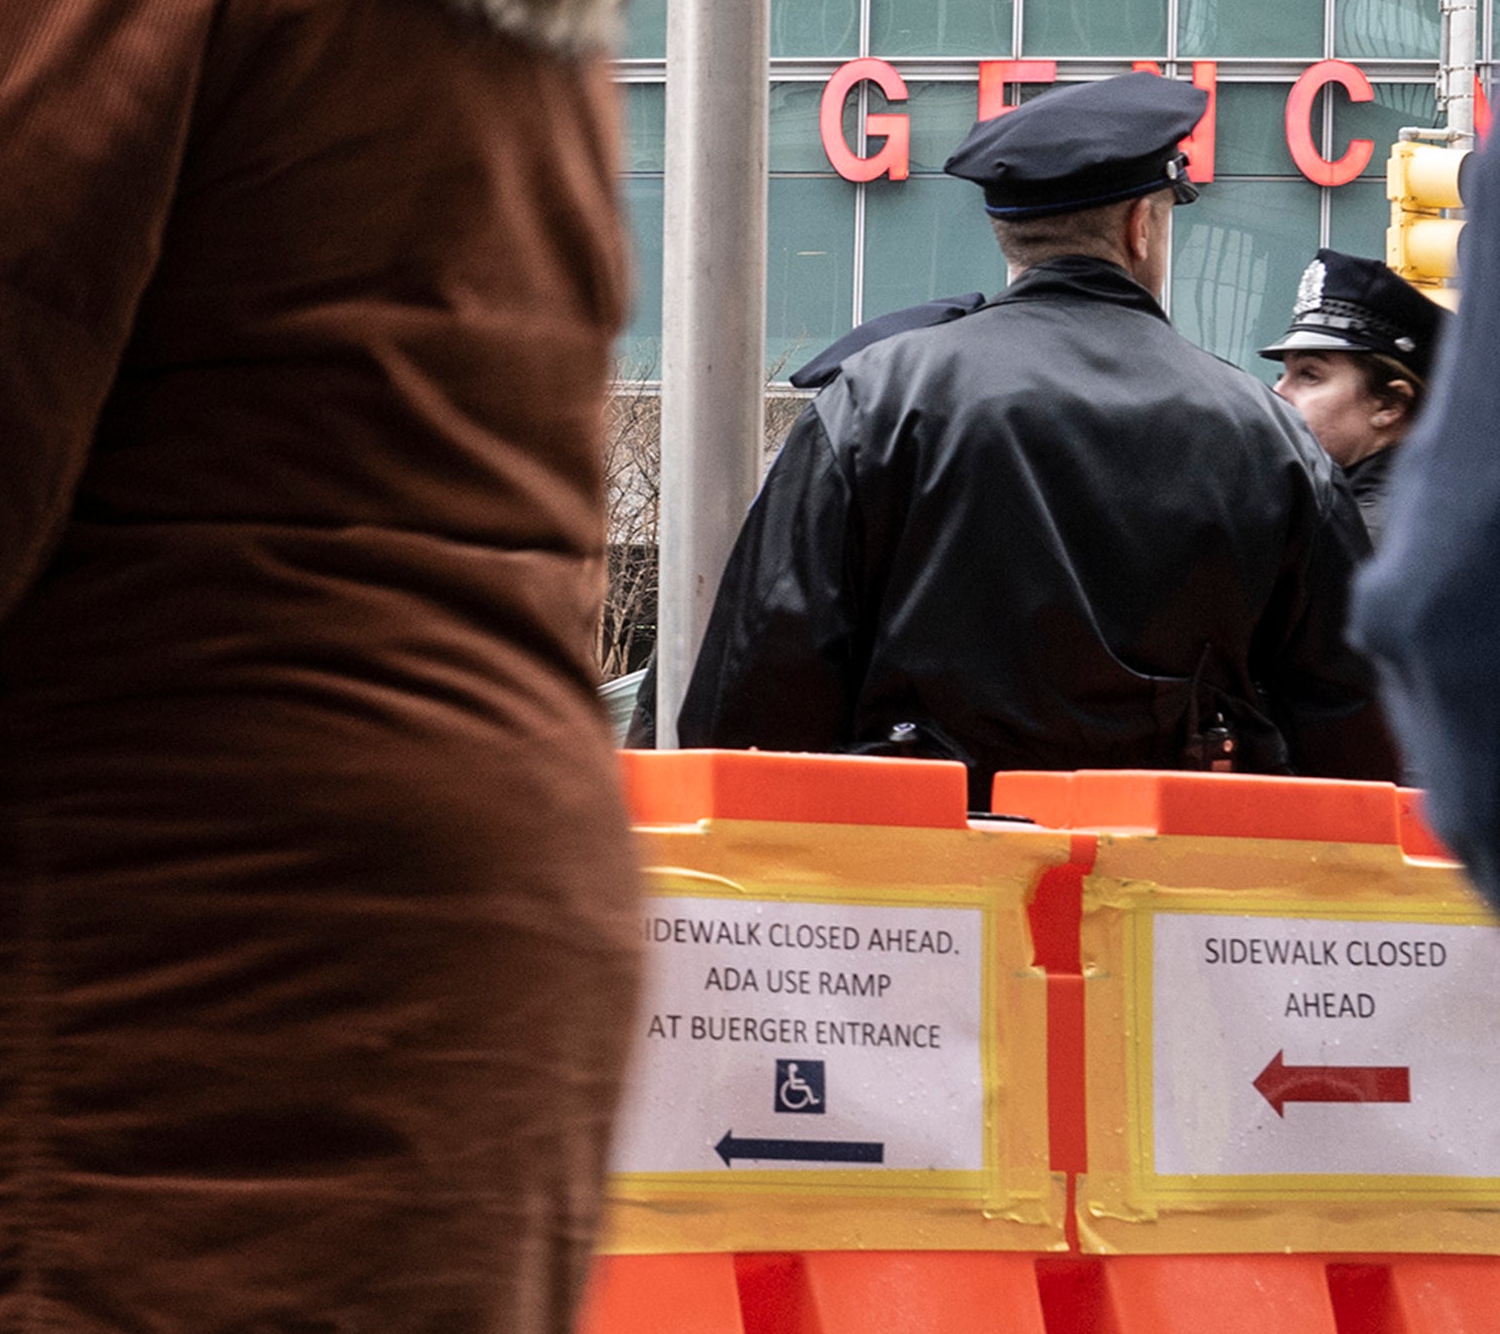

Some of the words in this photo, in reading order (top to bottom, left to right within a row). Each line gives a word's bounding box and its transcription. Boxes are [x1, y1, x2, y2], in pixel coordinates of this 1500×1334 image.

[638, 918, 761, 946] IDEWALK
[769, 923, 860, 951] CLOSED
[867, 928, 960, 955] AHEAD.
[1205, 938, 1339, 966] SIDEWALK
[1346, 941, 1447, 967] CLOSED
[705, 967, 759, 992] ADA
[767, 970, 810, 994] USE
[819, 973, 892, 998] RAMP
[1284, 993, 1376, 1019] AHEAD
[647, 1015, 682, 1039] AT
[691, 1016, 808, 1044] BUERGER
[816, 1020, 941, 1049] ENTRANCE
